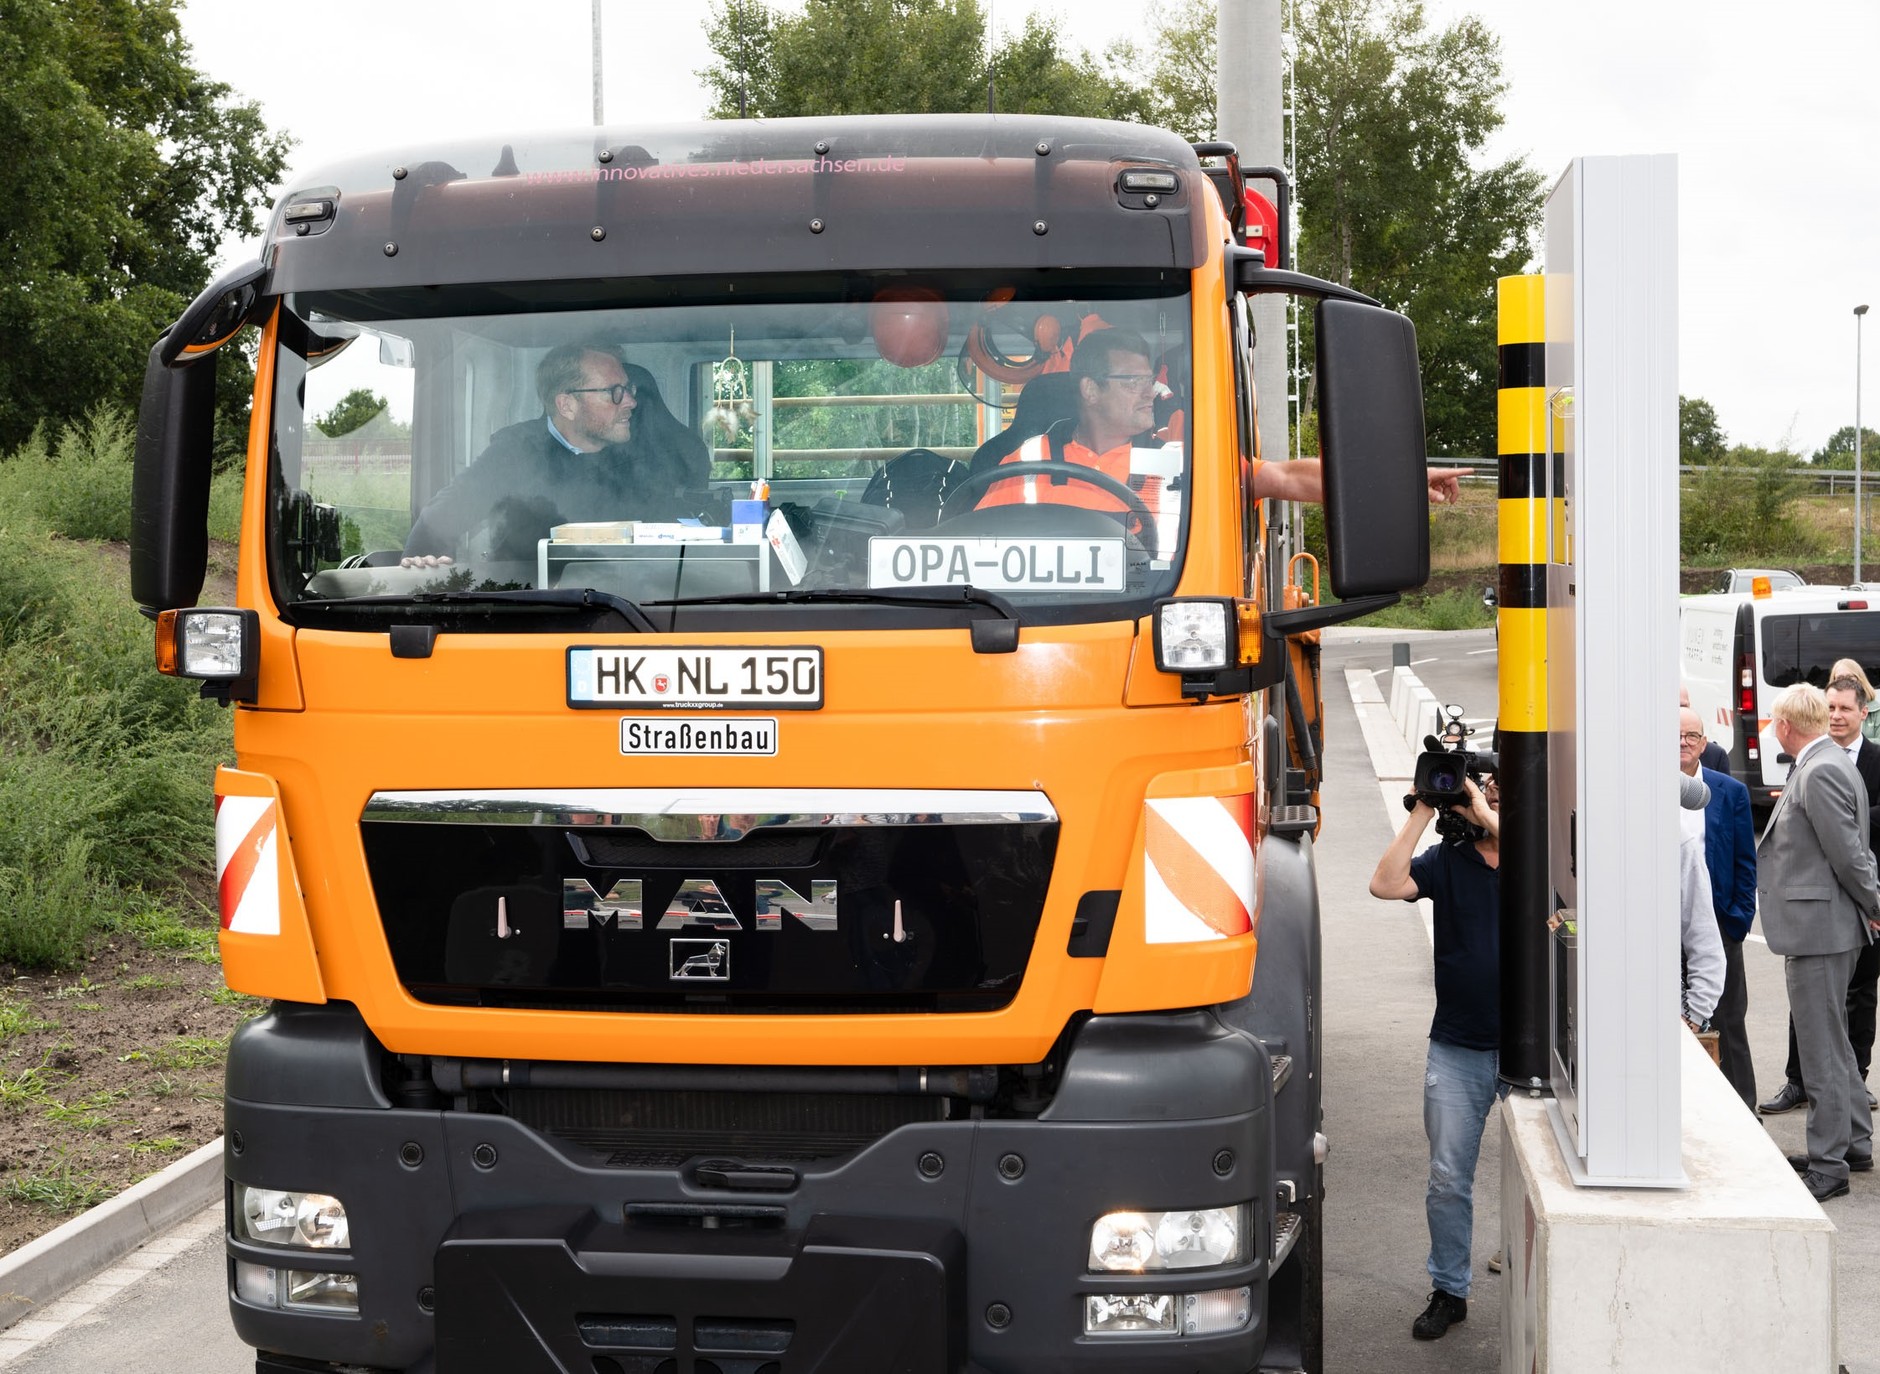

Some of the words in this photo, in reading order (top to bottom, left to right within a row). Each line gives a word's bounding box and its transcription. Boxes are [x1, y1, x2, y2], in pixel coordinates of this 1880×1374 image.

[527, 155, 905, 184] www.innovatives.niedersachsen.de
[891, 544, 1105, 584] OPA-OLLI
[596, 656, 647, 695] HK
[677, 656, 729, 695] NL
[740, 656, 816, 695] 150
[662, 701, 724, 709] www.truckxxgroup.de
[628, 722, 769, 750] Straßenbau
[563, 878, 838, 931] MAN
